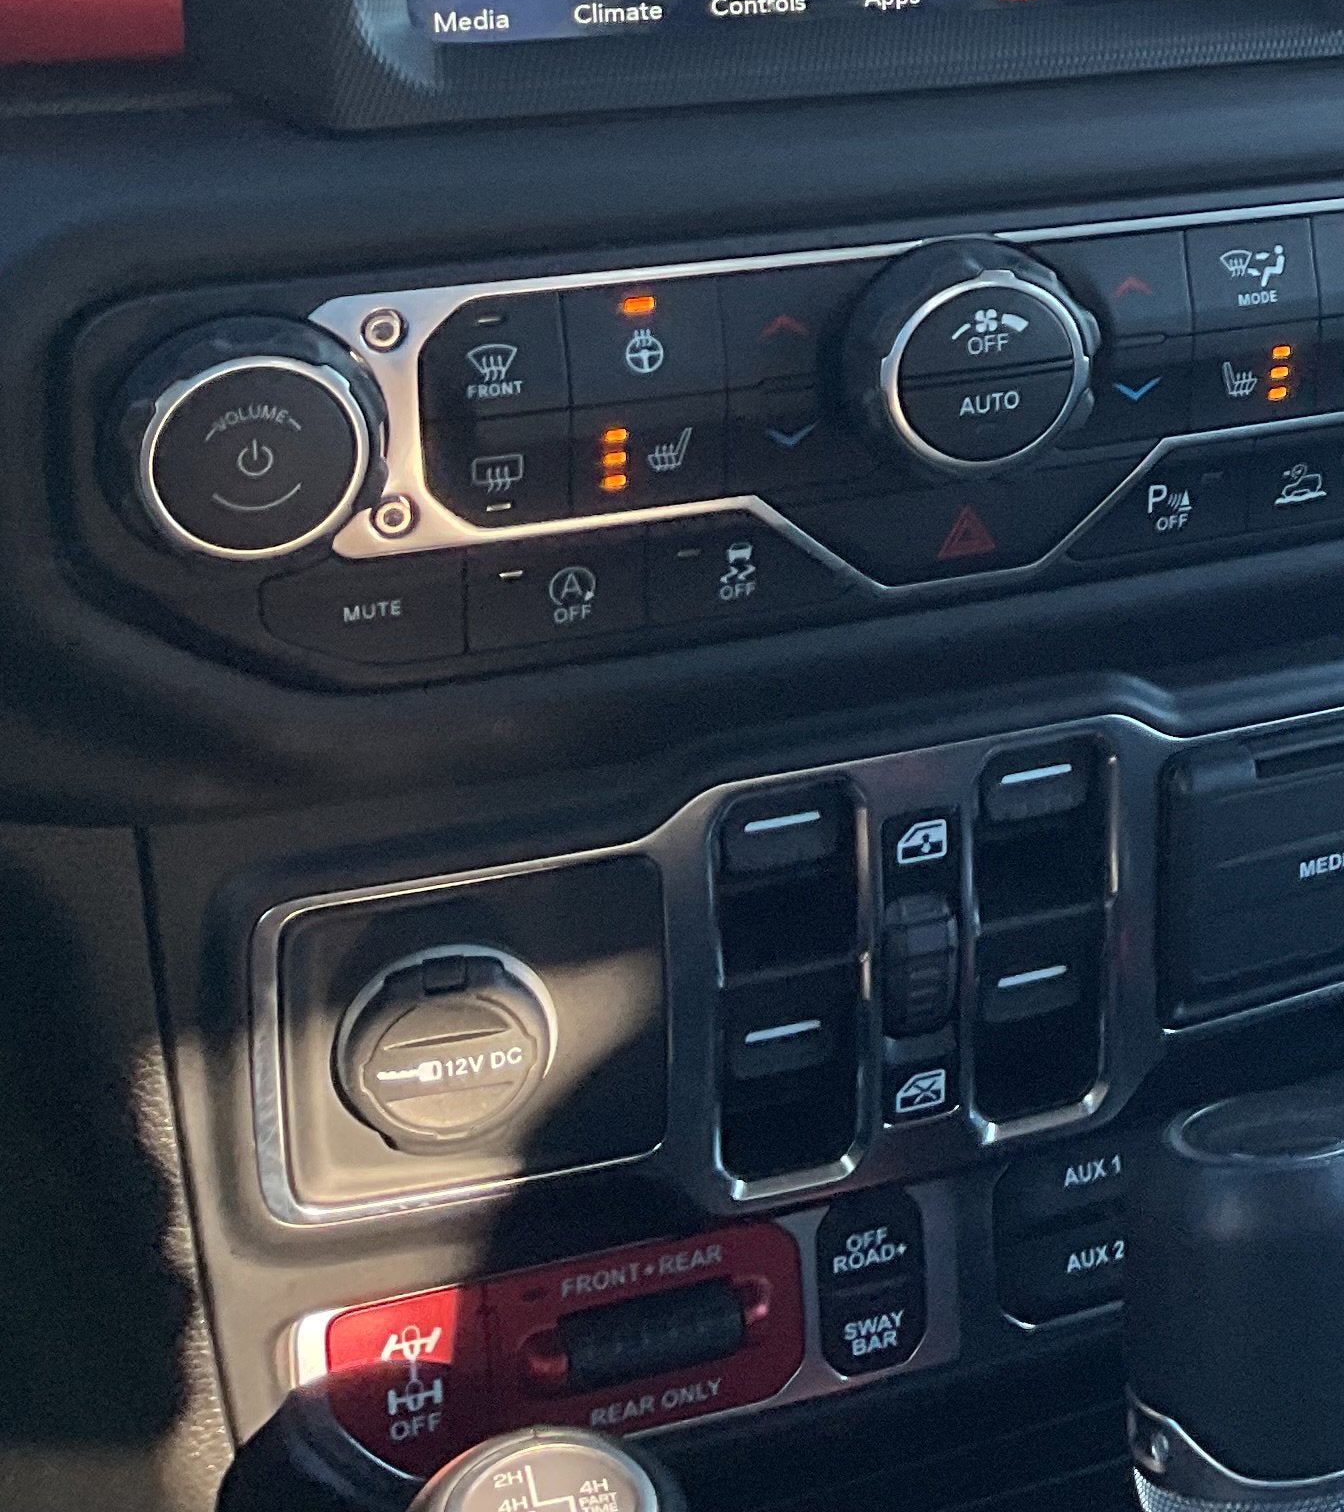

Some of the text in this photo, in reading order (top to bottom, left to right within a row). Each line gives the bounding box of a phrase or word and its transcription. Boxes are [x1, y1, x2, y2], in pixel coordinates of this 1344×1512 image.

[432, 9, 510, 35] Media
[573, 1, 664, 26] Climate
[1238, 290, 1279, 307] MODE
[966, 333, 1009, 356] OFF
[467, 380, 524, 400] FRONT
[959, 390, 1020, 417] AUTO
[213, 403, 290, 433] VOLUME
[1156, 511, 1190, 533] OFF
[719, 581, 756, 601] OFF
[343, 599, 402, 624] MUTE
[553, 604, 592, 625] OFF
[445, 1046, 523, 1078] 12V DC
[1063, 1153, 1123, 1188] AUX 1
[846, 1226, 888, 1254] OFF
[1066, 1240, 1126, 1274] AUX 2
[843, 1309, 905, 1341] SWAY
[850, 1330, 898, 1356] BAR
[590, 1377, 723, 1427] REAR ONLY
[389, 1411, 442, 1442] OFF
[493, 1467, 524, 1488] 2H
[578, 1478, 609, 1494] 4H
[498, 1495, 528, 1512] 4H
[578, 1491, 617, 1508] PART
